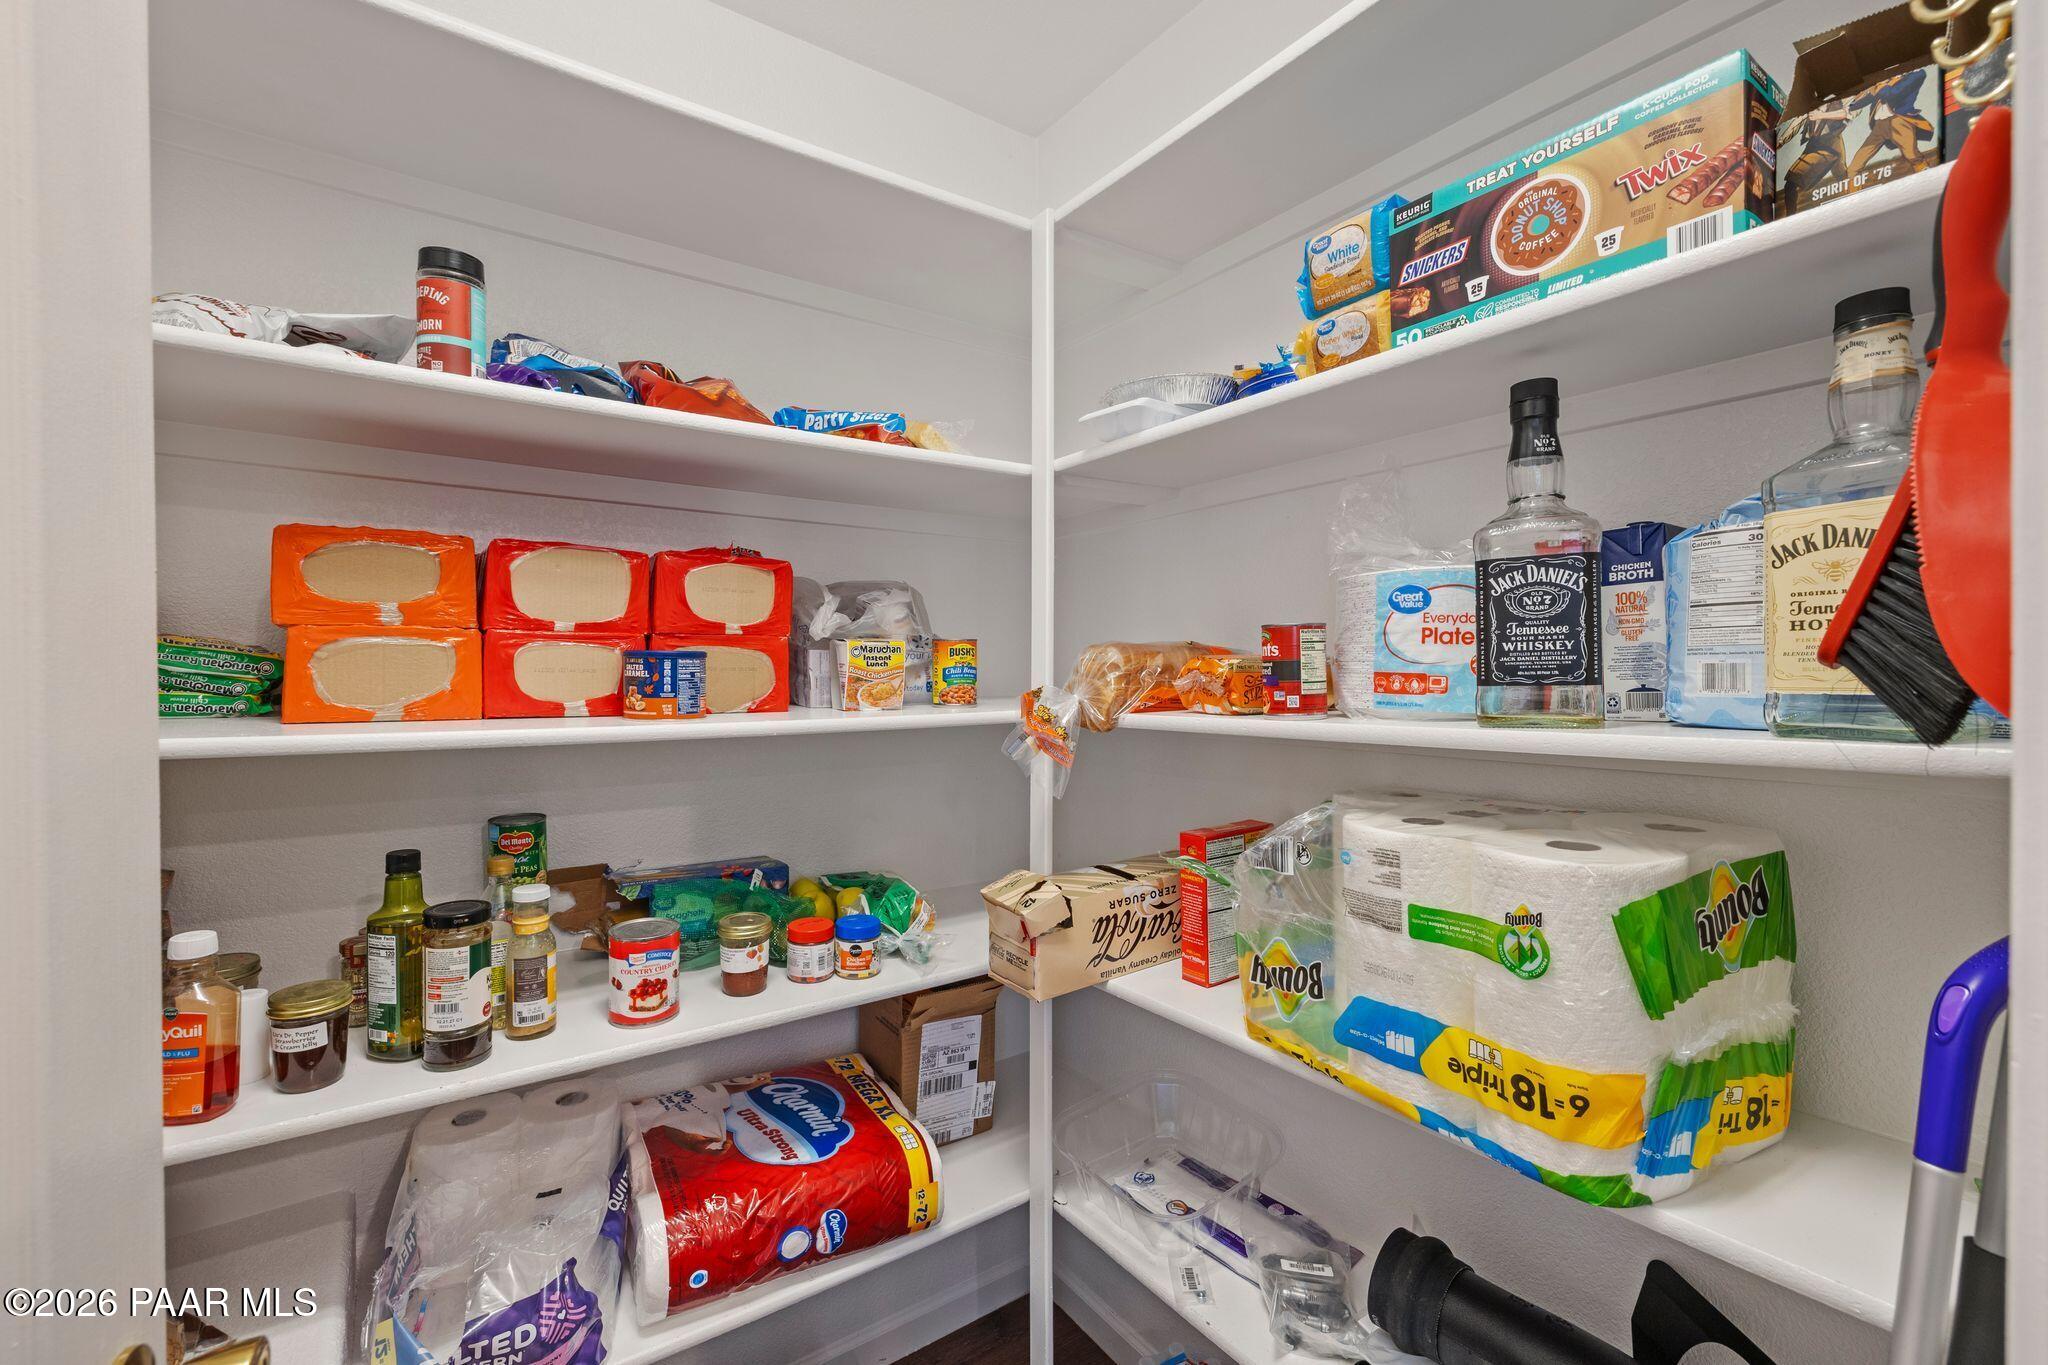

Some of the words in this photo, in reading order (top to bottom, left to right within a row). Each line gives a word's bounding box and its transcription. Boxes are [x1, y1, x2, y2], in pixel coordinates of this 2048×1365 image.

[1685, 74, 1710, 90] POD
[1634, 104, 1665, 120] COFFEE
[1667, 78, 1719, 106] COLLECTION
[1466, 162, 1517, 194] TREAT
[1522, 113, 1620, 170] YOURSELF
[1812, 178, 1850, 201] SPIRIT
[1854, 171, 1869, 188] OF
[1518, 186, 1558, 209] ORIGINAL
[1396, 200, 1432, 222] KEURIG
[1511, 198, 1541, 244] DONUT
[1542, 197, 1568, 226] SHOP
[1519, 228, 1559, 251] COFFEE
[1601, 234, 1616, 248] 25
[1327, 242, 1360, 264] White
[1402, 240, 1466, 282] SNICKERS
[1324, 258, 1346, 274] Sandwich
[1346, 253, 1361, 265] Bread
[1470, 282, 1484, 294] 25
[1547, 274, 1584, 294] LIMITED
[1320, 334, 1340, 348] Honey
[1341, 325, 1363, 340] Wheat
[1396, 328, 1423, 347] 50
[1864, 350, 1892, 358] HONEY
[804, 412, 850, 430] Party
[1692, 540, 1722, 549] Calories
[1748, 533, 1764, 542] 30
[1771, 532, 1820, 570] JACK
[1611, 560, 1652, 572] CHICKEN
[1489, 569, 1526, 596] JACK
[1526, 564, 1588, 593] DANIEL'S
[1608, 568, 1654, 582] BROTH
[1392, 591, 1424, 602] Great
[1543, 596, 1552, 604] 7
[1615, 591, 1648, 606] 100%
[1790, 590, 1838, 598] ORIGINAL
[1400, 600, 1424, 608] Value
[1615, 604, 1648, 614] NATURAL
[1422, 612, 1476, 626] Everyda
[1618, 618, 1645, 626] NON-GMO
[1421, 627, 1475, 645] Plate
[1506, 622, 1570, 636] Tennessee
[859, 644, 902, 654] Maruchan
[950, 648, 976, 658] BUSH'S
[1502, 640, 1575, 652] WHISKEY
[202, 658, 261, 674] Maruchan
[862, 654, 892, 662] Instant
[624, 670, 650, 678] CARAMEL
[849, 666, 867, 678] Roast
[867, 670, 890, 680] Chicken
[174, 677, 234, 696] Maruchan
[176, 704, 236, 714] Maruchan
[500, 838, 510, 846] Del
[511, 837, 532, 845] Monte
[519, 864, 538, 874] PEAS
[1150, 884, 1177, 898] ZERO
[1021, 896, 1037, 908] 12
[1108, 894, 1146, 909] SUGAR
[1694, 865, 1770, 954] Bounty
[1504, 912, 1543, 928] Bounty
[1006, 950, 1028, 966] RECYCLE
[1160, 947, 1182, 962] oliday
[1100, 963, 1128, 978] Vanilla
[1128, 955, 1158, 972] Creamy
[620, 968, 653, 976] COUNTRY
[1250, 954, 1324, 1000] Bounty
[162, 1024, 202, 1042] yQuil
[295, 1029, 318, 1038] Pepper
[302, 1041, 318, 1049] Jelly
[177, 1050, 191, 1058] FLU
[1448, 1056, 1508, 1103] Triple
[846, 1074, 876, 1104] MEGA
[876, 1102, 896, 1122] XL
[761, 1083, 839, 1137] Charmin
[1718, 1112, 1742, 1135] Tri
[736, 1108, 766, 1136] Ultra
[763, 1126, 801, 1162] Strong
[607, 1166, 628, 1212] QUIL
[917, 1188, 926, 1200] 12
[916, 1204, 928, 1224] 72
[828, 1212, 842, 1244] Charmin
[455, 1324, 537, 1365] LTED
